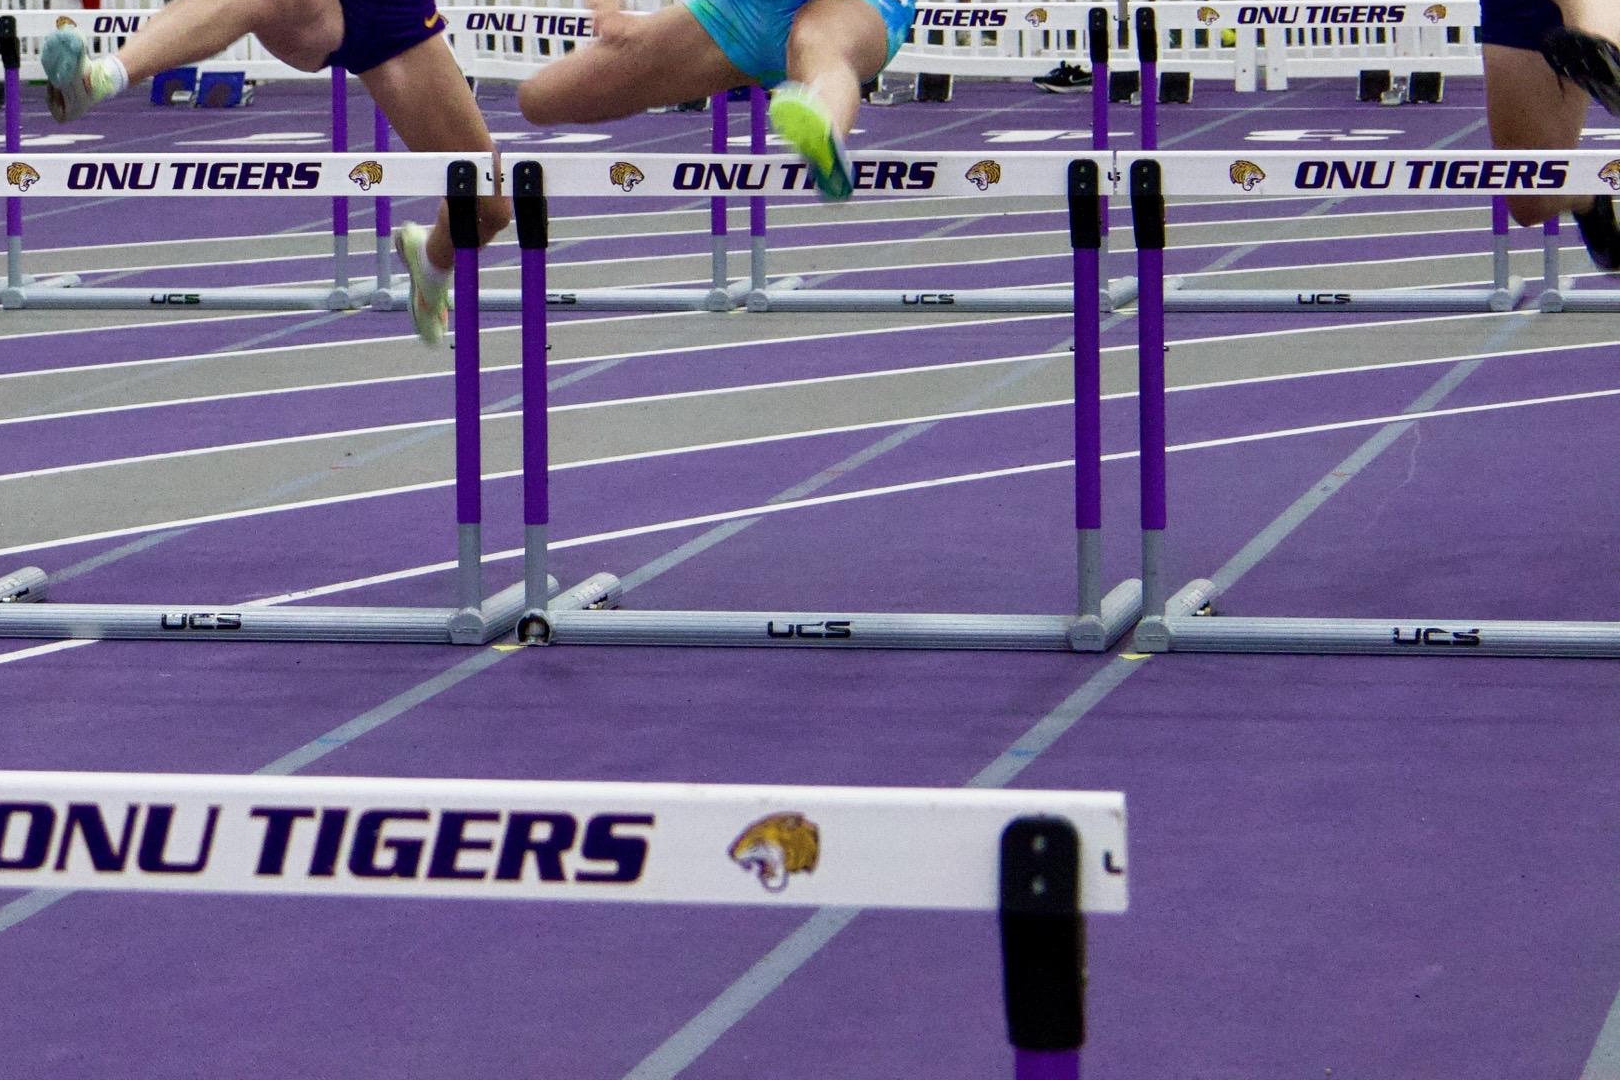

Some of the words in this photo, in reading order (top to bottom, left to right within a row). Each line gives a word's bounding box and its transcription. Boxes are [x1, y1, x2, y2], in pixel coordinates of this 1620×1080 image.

[1237, 5, 1298, 24] ONU
[1306, 4, 1406, 24] TIGERS
[466, 12, 526, 31] ONU
[533, 14, 598, 37] TIGE
[67, 162, 160, 190] ONU
[170, 162, 322, 190] TIGERS
[673, 162, 770, 190] ONU
[779, 161, 937, 190] TIERS
[1294, 160, 1395, 189] ONU
[1405, 160, 1570, 189] TIGERS
[150, 293, 201, 305] UCS
[547, 293, 577, 304] CS
[901, 293, 955, 305] UCS
[1296, 292, 1351, 305] UCS
[161, 613, 241, 631] UCS
[766, 620, 852, 639] UCS
[1393, 627, 1481, 647] UCS
[248, 805, 657, 883] TIGERS
